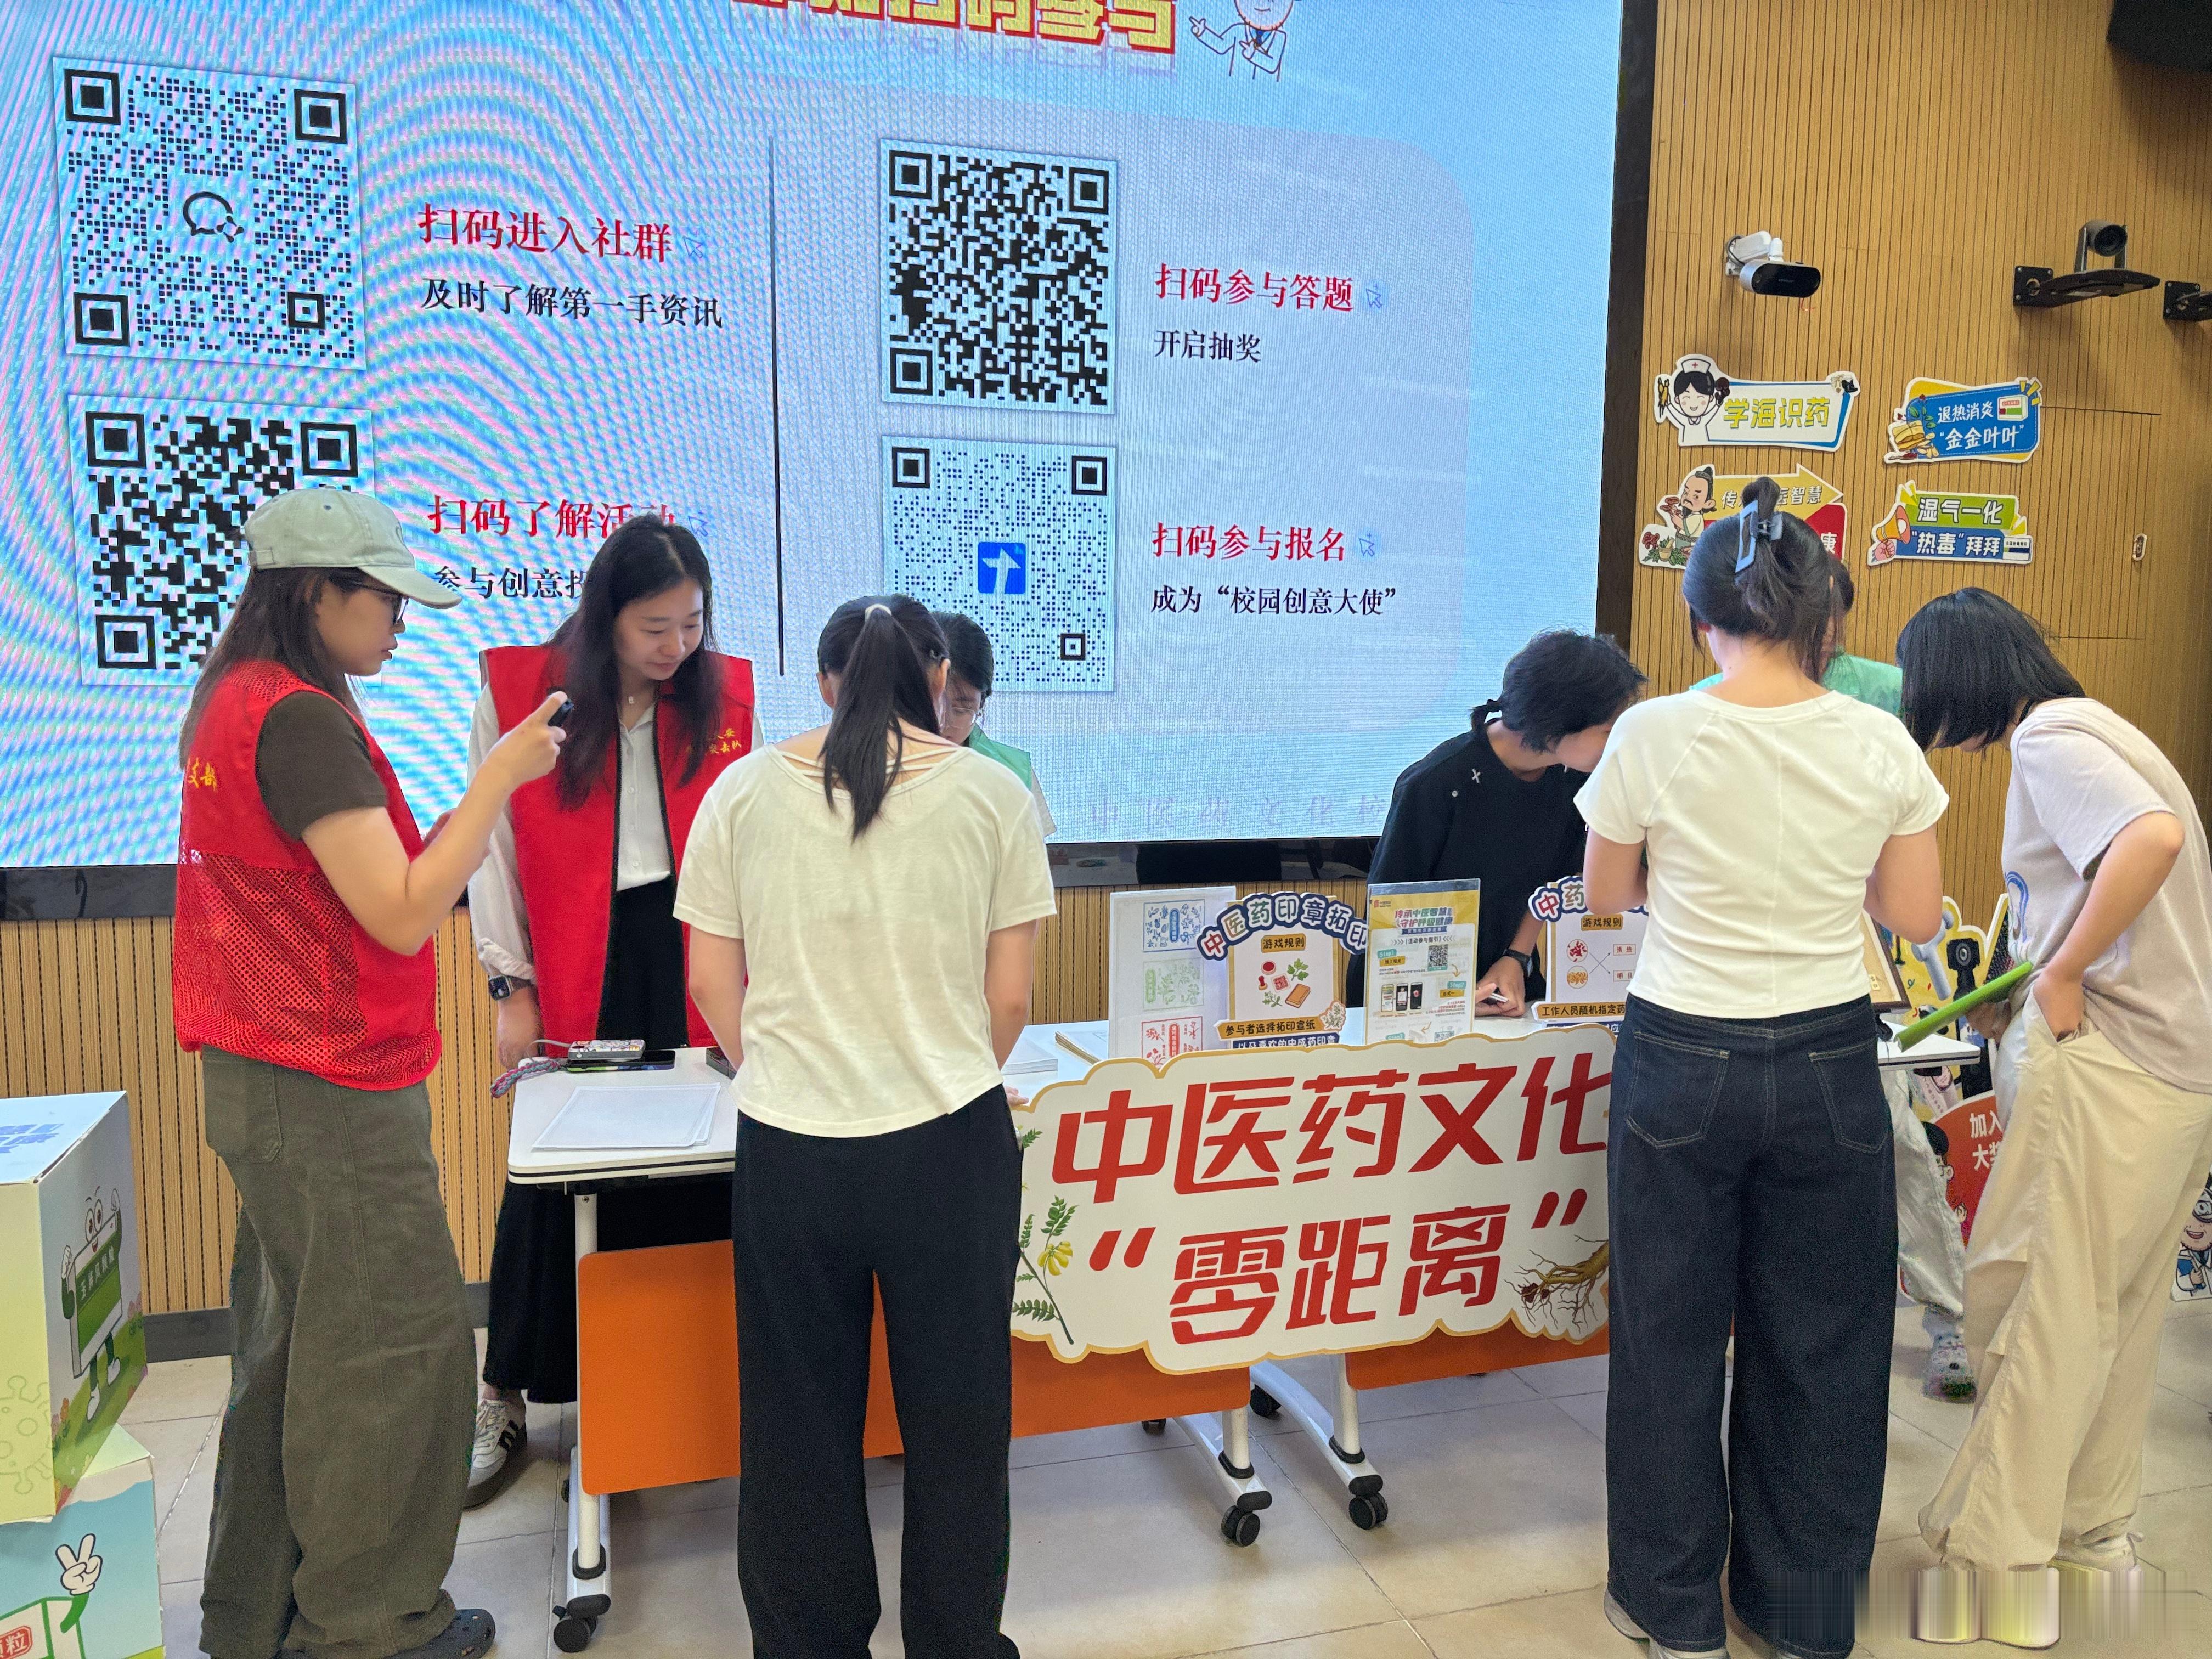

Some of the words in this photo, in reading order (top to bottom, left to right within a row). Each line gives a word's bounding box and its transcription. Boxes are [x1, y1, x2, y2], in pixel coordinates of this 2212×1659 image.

[418, 202, 672, 262] 扫码进入社群
[1155, 262, 1353, 312] 扫码参与答题
[421, 278, 723, 328] 及时了解第一手资讯
[1154, 330, 1261, 363] 开启抽奖
[1723, 397, 1830, 428] 学海识药
[1937, 400, 1994, 424] 退热消炎
[1722, 486, 1822, 509] 传医智慧
[1917, 497, 2004, 525] 湿气一化
[1152, 522, 1345, 561] 扫码参与报名
[1151, 585, 1396, 616] 成为“校园创意大使”
[1583, 917, 1622, 927] 游戏规则
[1262, 936, 1305, 949] 游戏规则
[1226, 1019, 1316, 1036] 参与者选择拓印宣纸
[1052, 1053, 1611, 1203] 中医药文化
[1969, 1110, 2003, 1138] 加入
[1088, 1188, 1588, 1345] “零距离”
